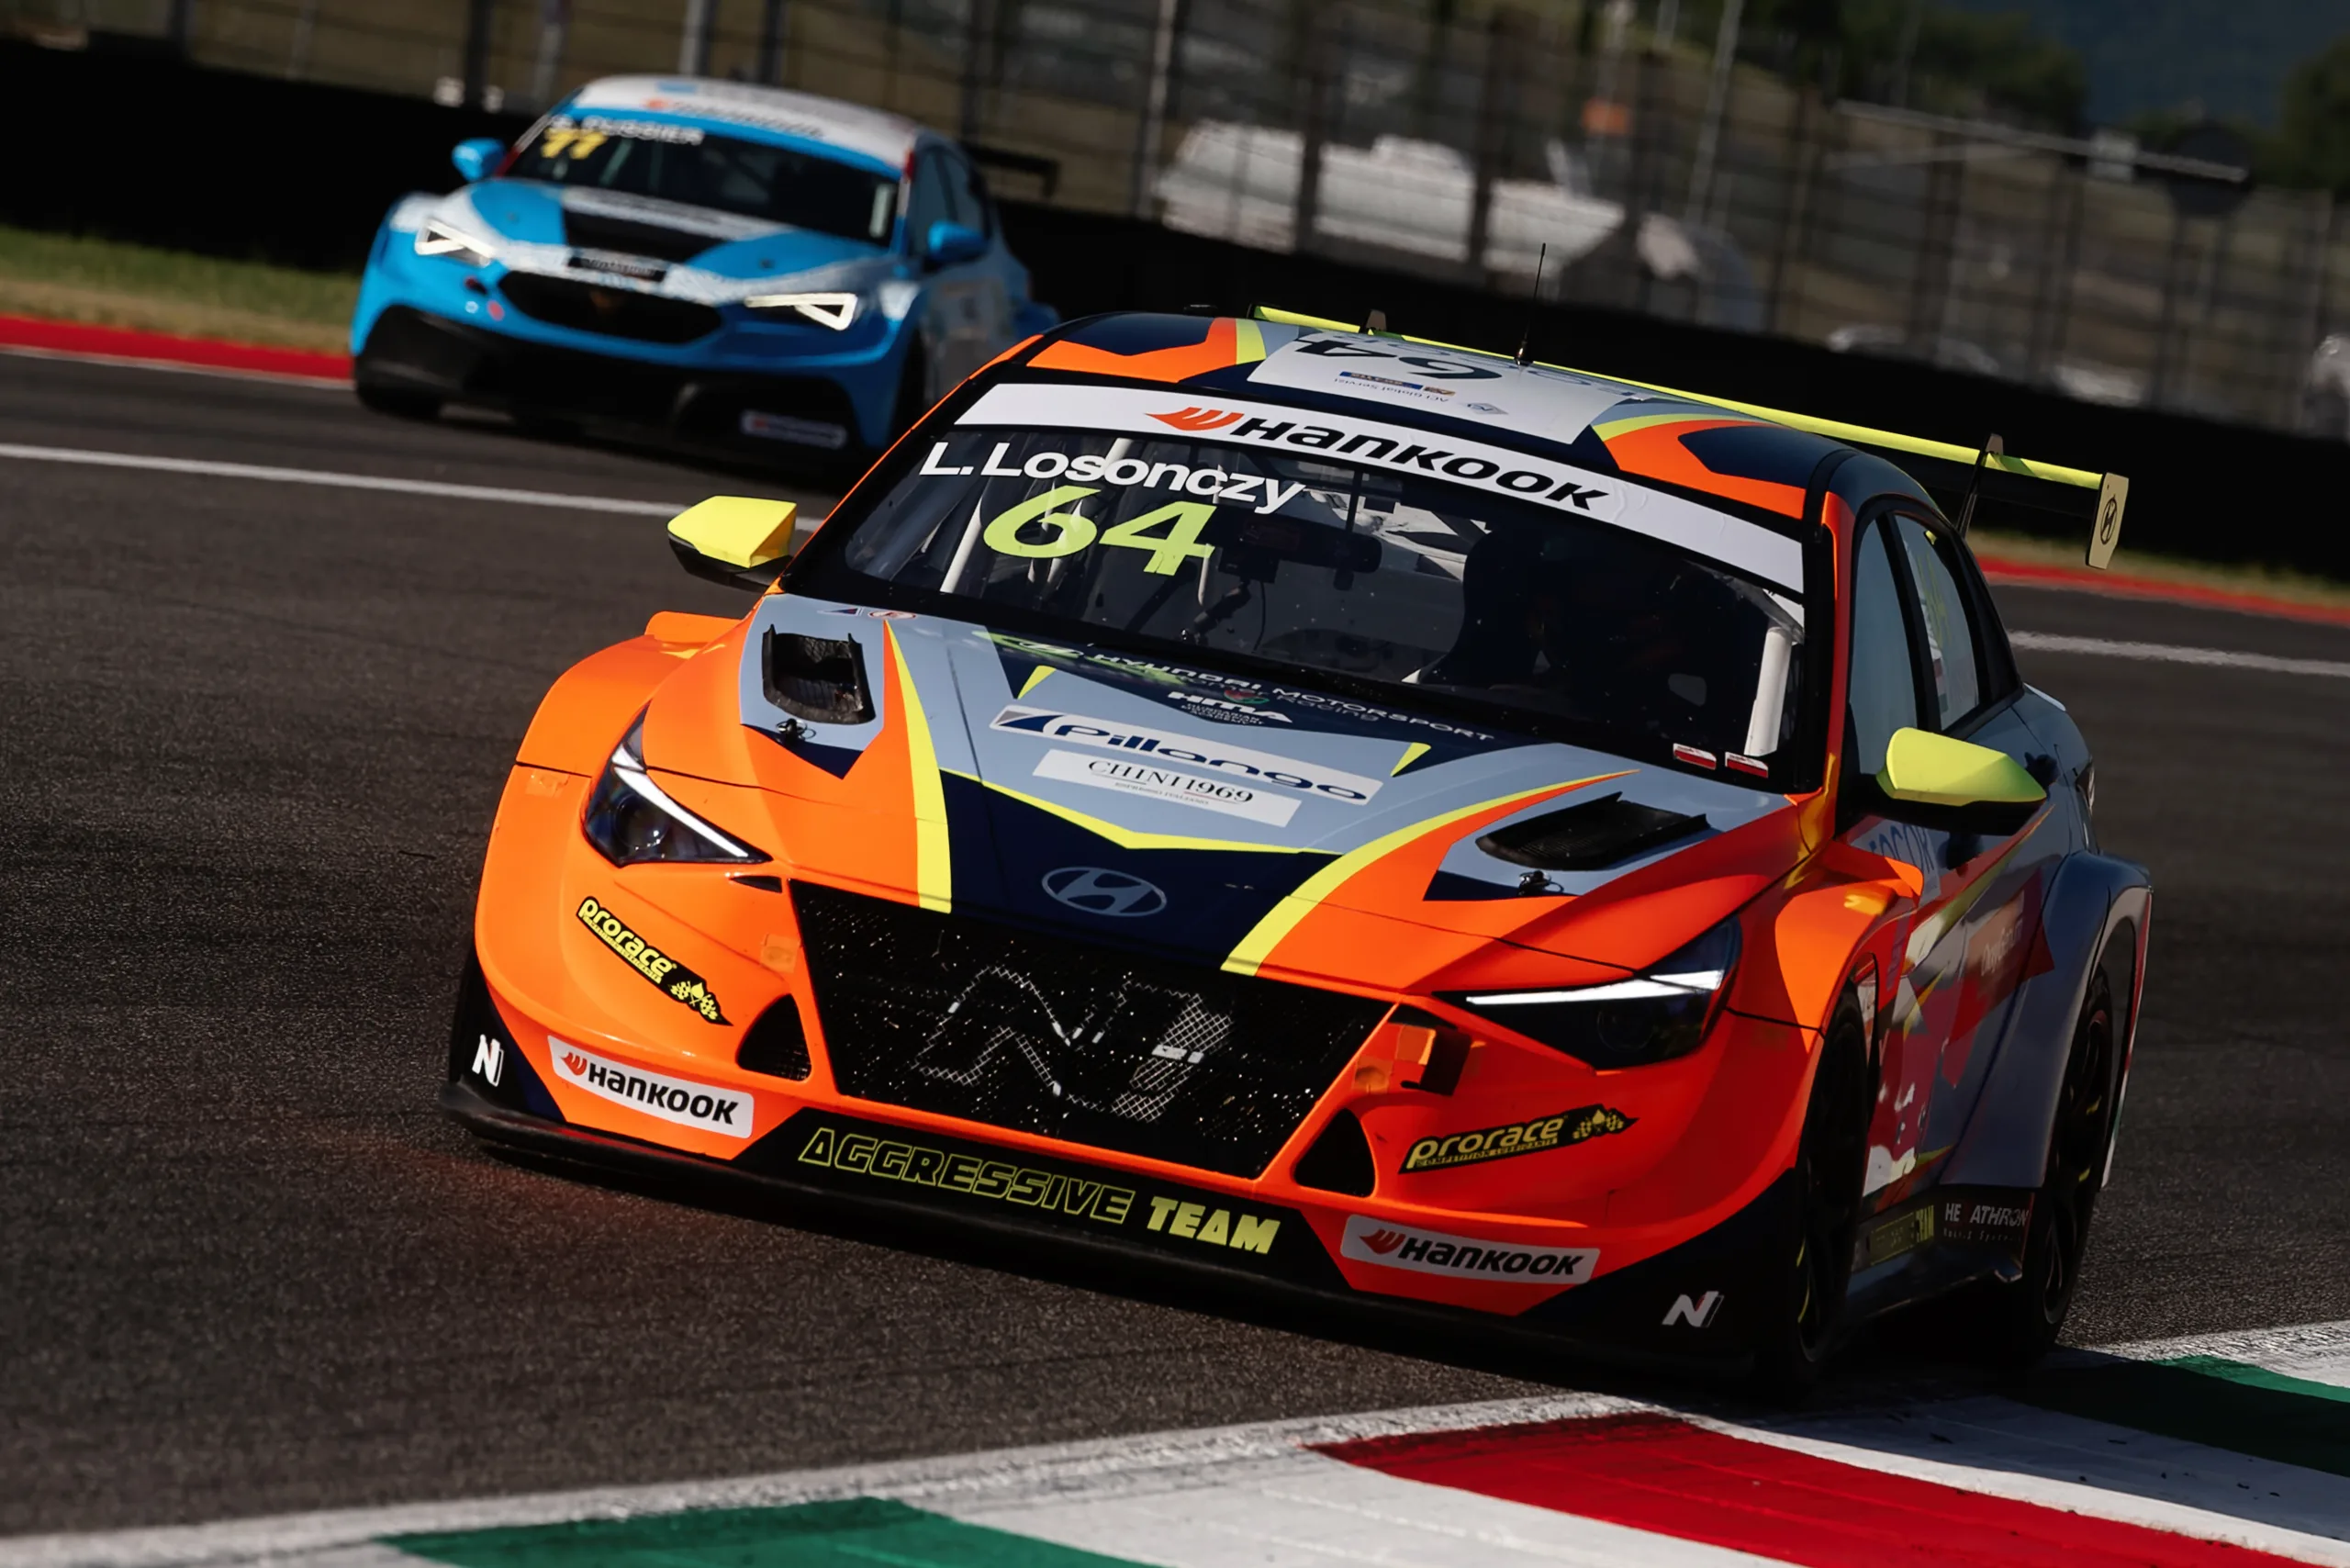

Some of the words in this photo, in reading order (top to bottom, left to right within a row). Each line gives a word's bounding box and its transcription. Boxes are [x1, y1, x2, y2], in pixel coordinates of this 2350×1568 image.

[983, 485, 1217, 577] 64
[1272, 687, 1495, 743] MOTORSPORT
[578, 899, 674, 973] prorace
[1405, 1117, 1564, 1170] prorace
[798, 1126, 1136, 1225] AGGRESSIVE
[1147, 1195, 1281, 1255] TEAM
